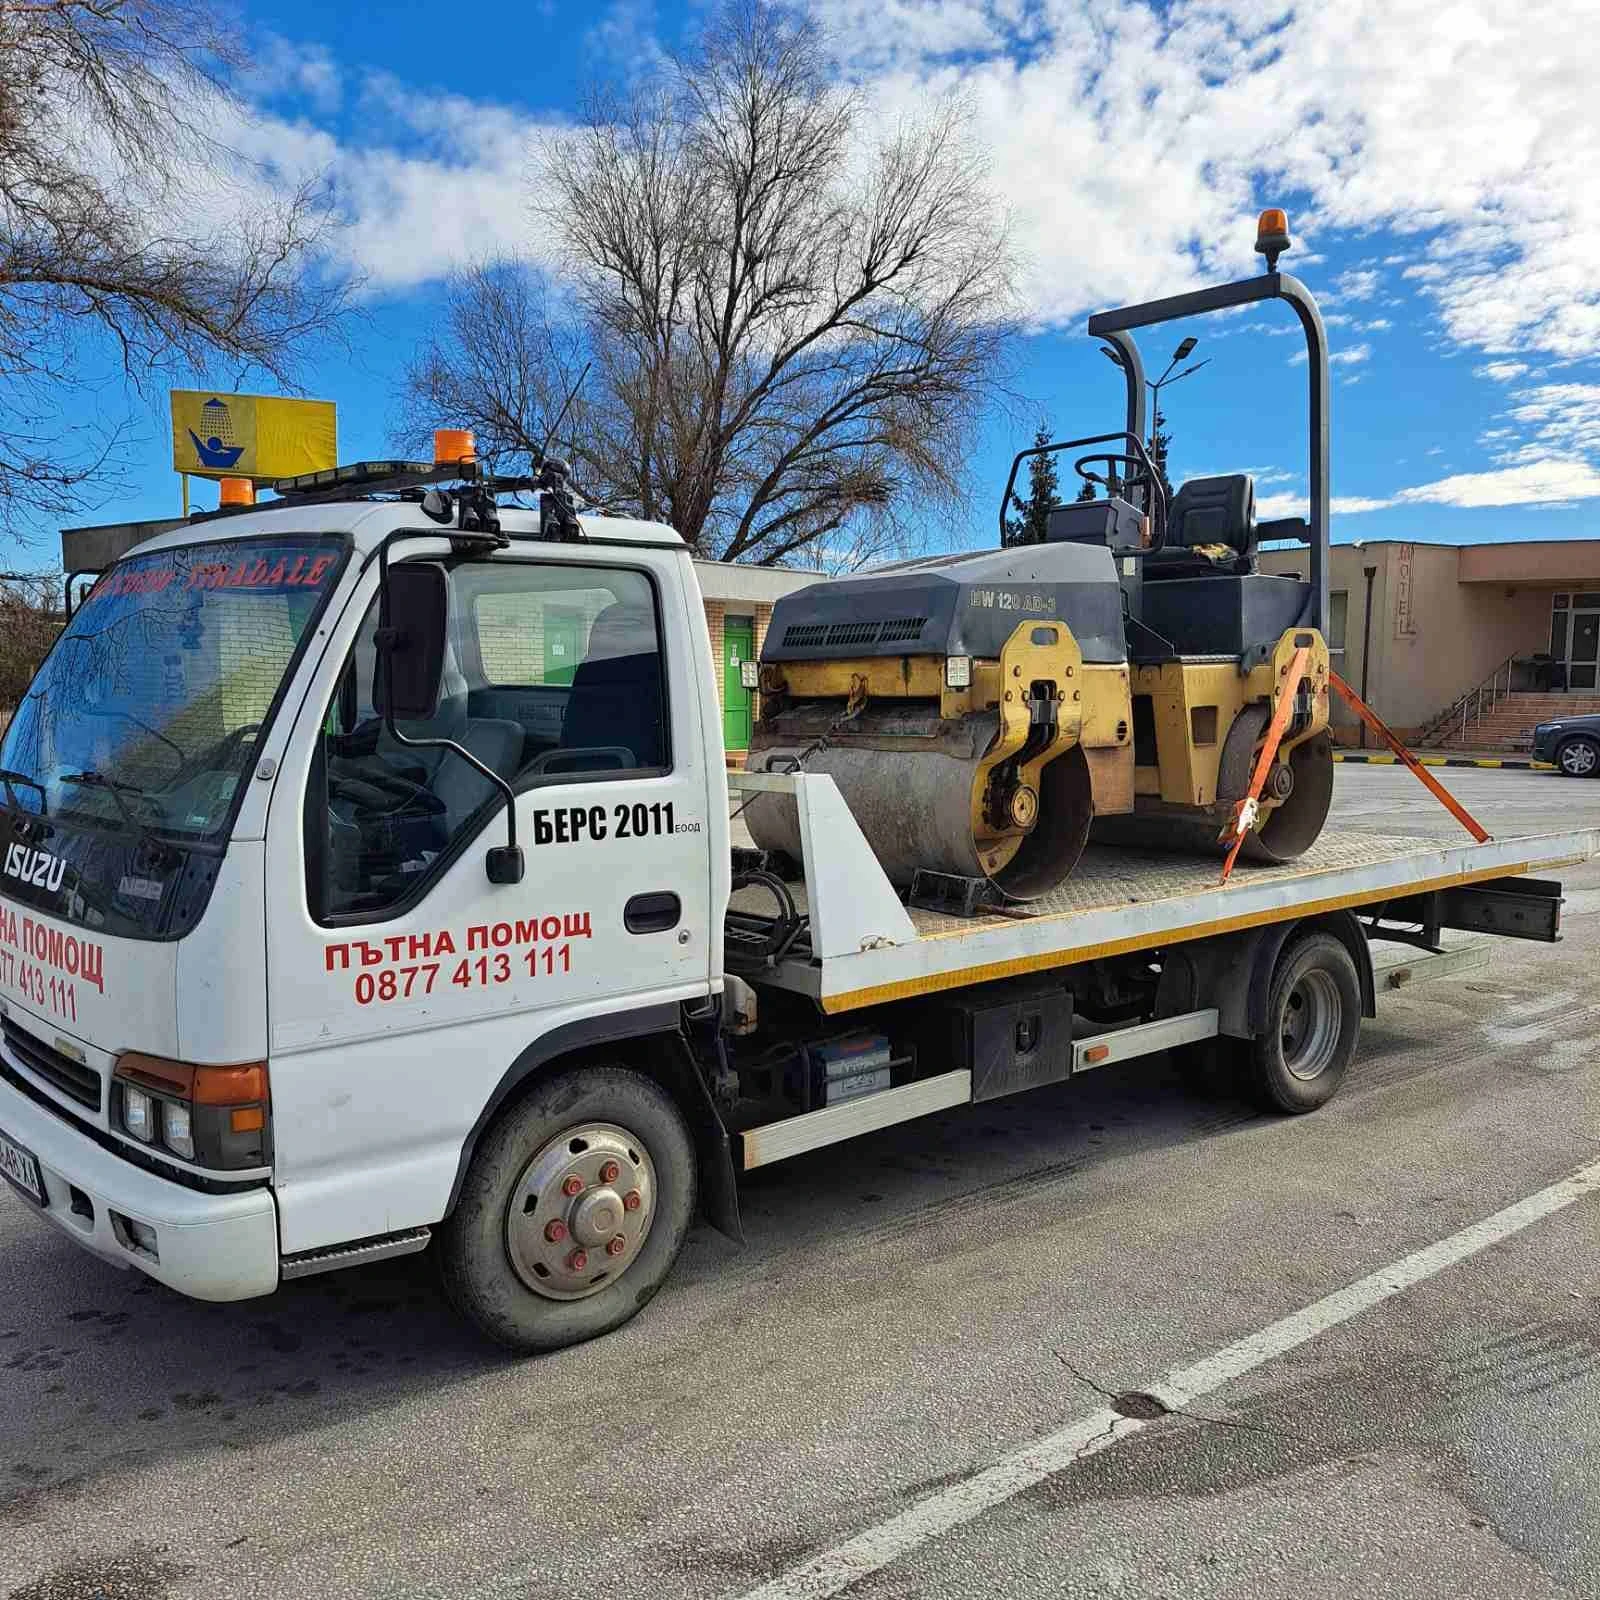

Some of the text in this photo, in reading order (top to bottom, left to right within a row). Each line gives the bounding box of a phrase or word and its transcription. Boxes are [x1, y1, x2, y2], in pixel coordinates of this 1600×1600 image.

[533, 801, 701, 845] БЕРС 2011 ЕООД
[3, 842, 67, 892] ISUZU
[23, 917, 104, 994] ПОМОЩ
[324, 911, 592, 971] ПЪТНА ПОМОЩ
[20, 959, 45, 1006] 413
[49, 975, 77, 1023] 111
[355, 943, 570, 1005] 0877 413 111
